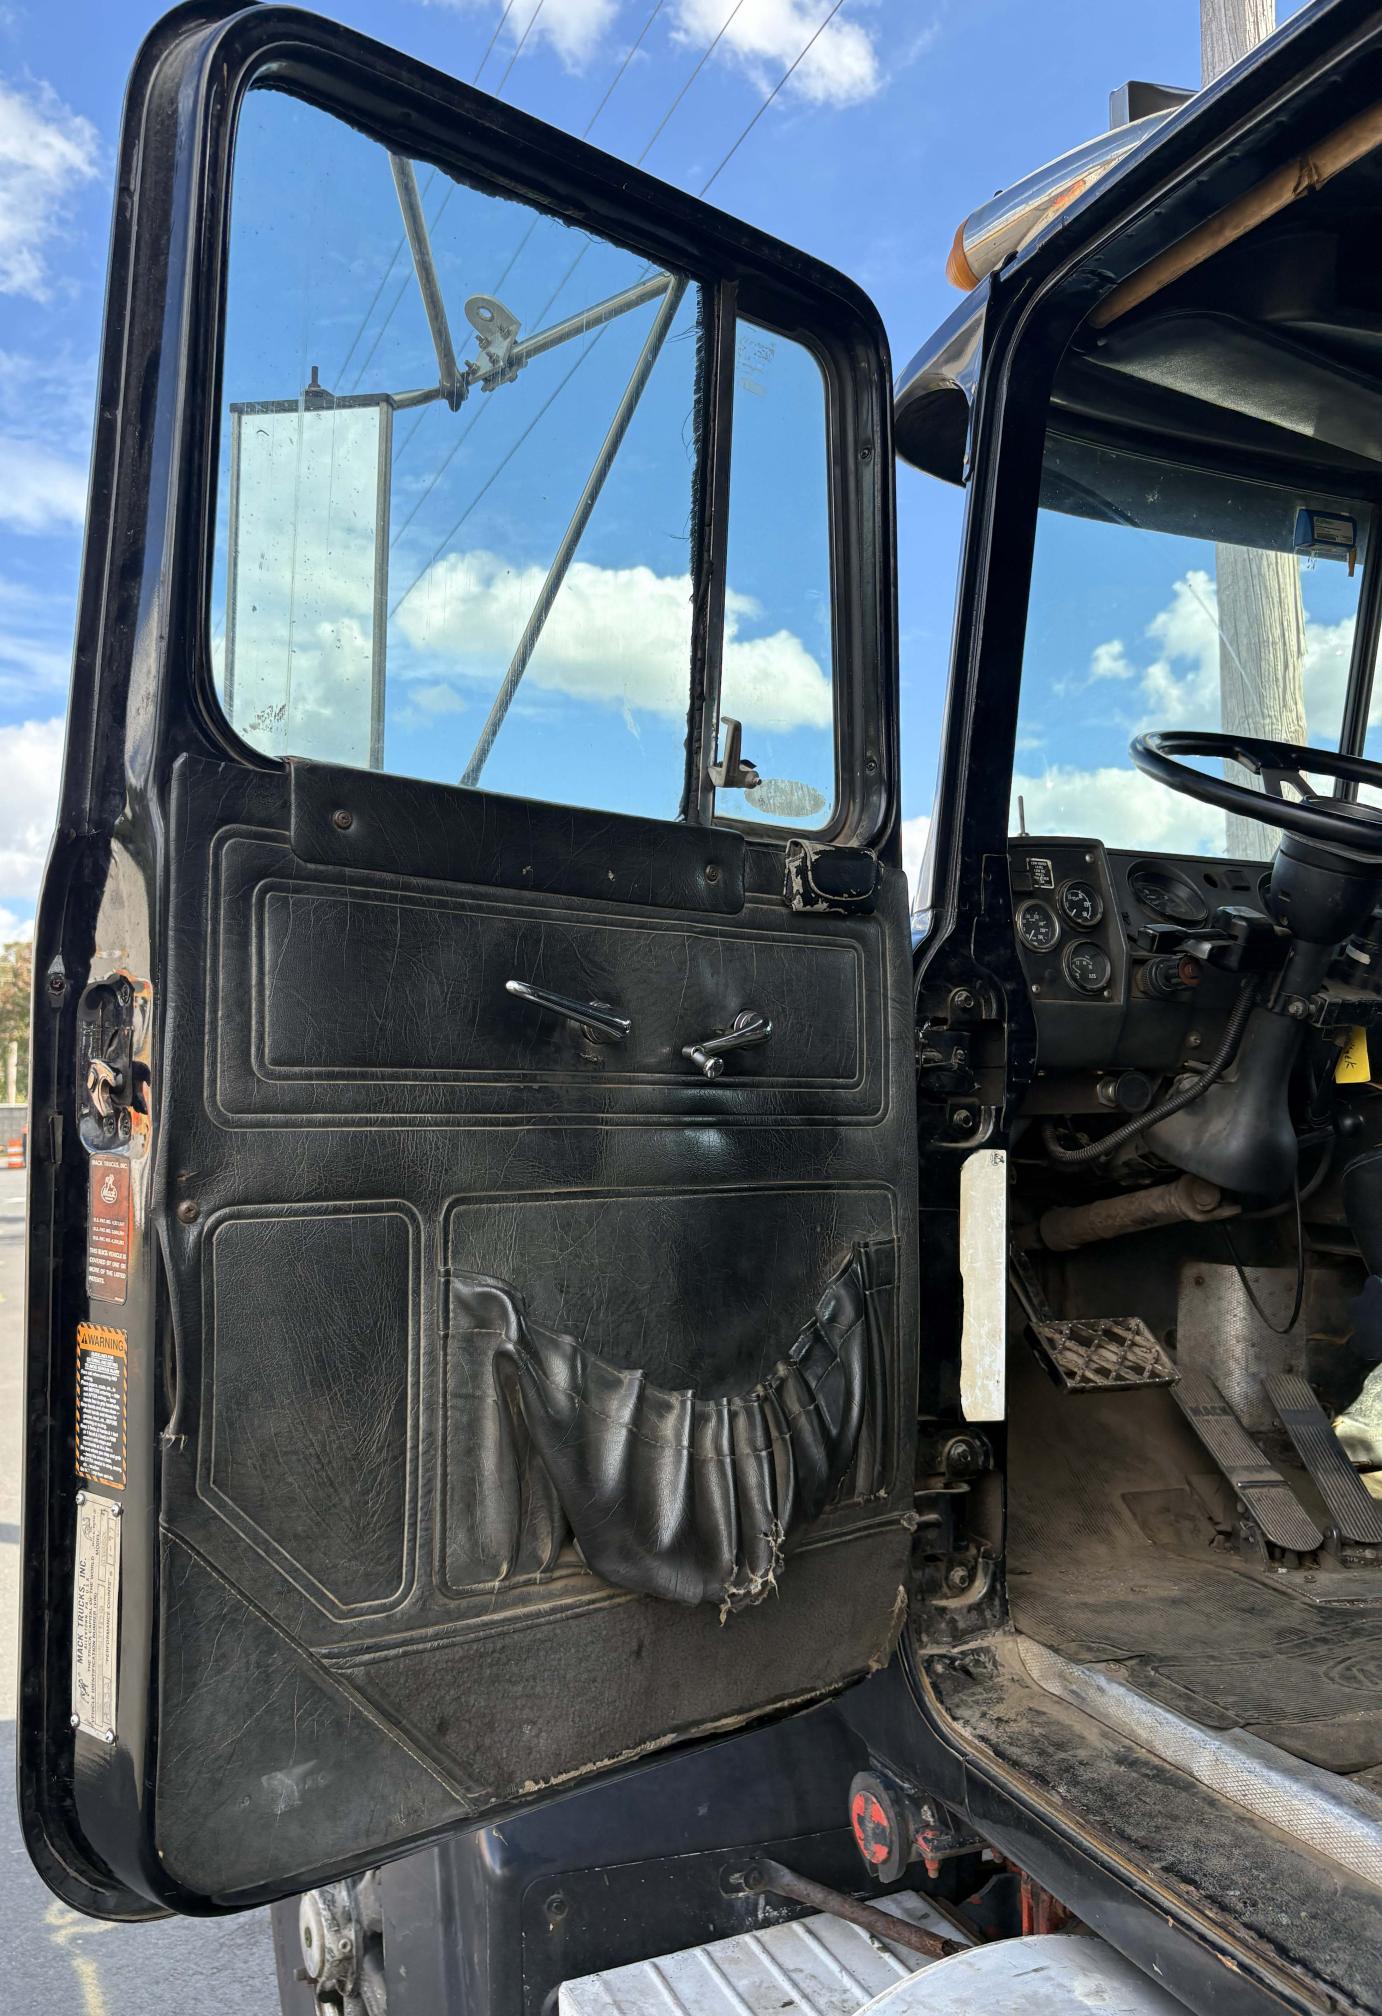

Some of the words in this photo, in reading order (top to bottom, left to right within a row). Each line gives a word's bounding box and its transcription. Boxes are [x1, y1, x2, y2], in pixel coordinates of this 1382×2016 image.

[88, 1333, 124, 1351] WARNING
[79, 1557, 87, 1578] INC.
[77, 1583, 86, 1628] TRUCKS,
